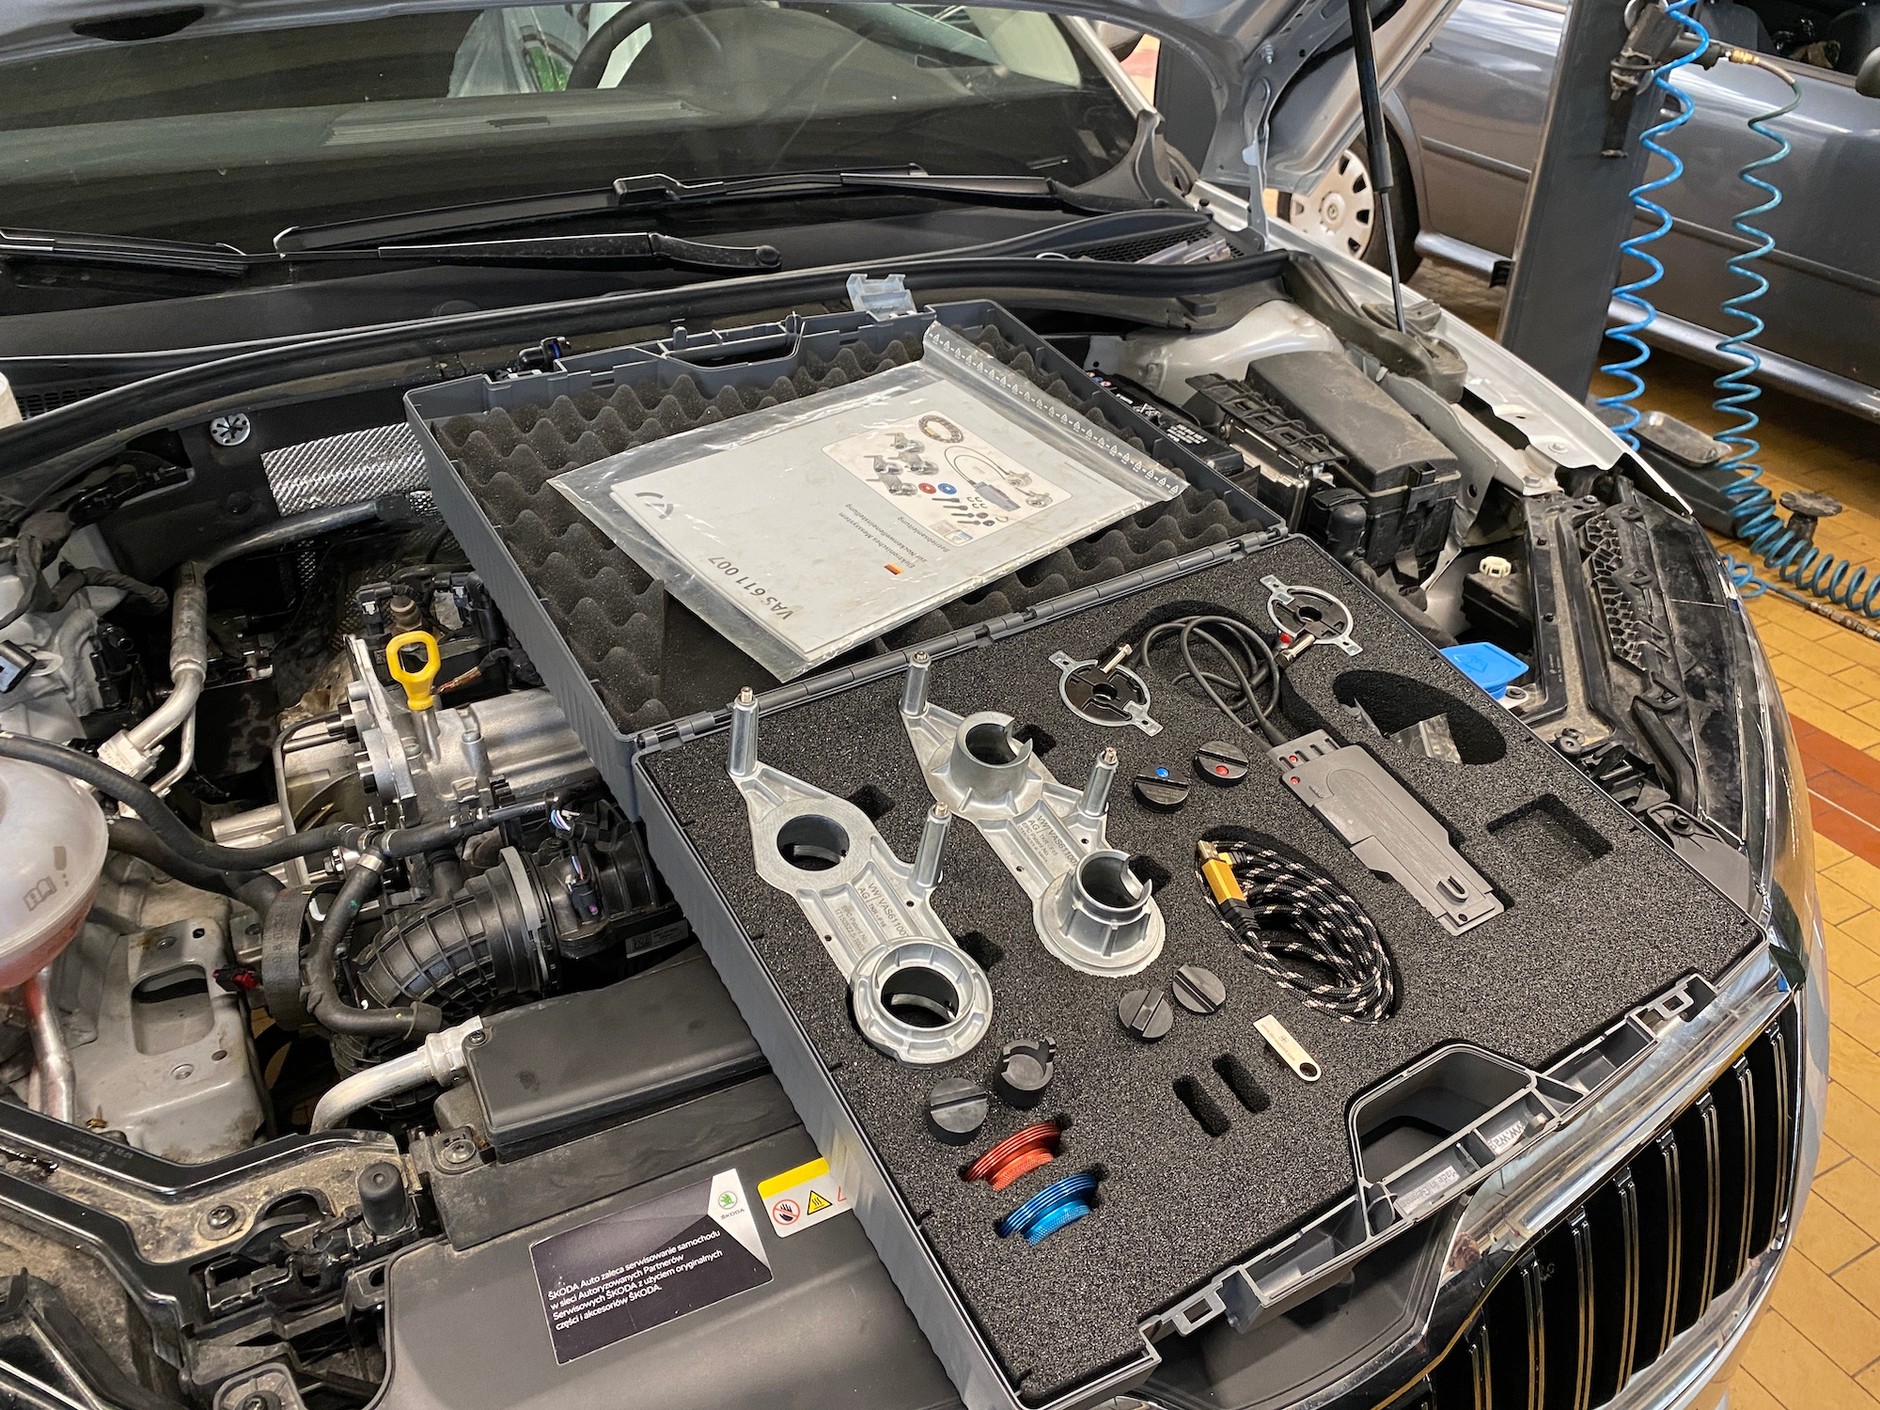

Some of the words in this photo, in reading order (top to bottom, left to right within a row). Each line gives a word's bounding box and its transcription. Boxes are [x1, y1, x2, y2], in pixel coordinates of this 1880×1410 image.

[872, 537, 916, 569] Elektronisches
[707, 557, 740, 576] 007
[735, 576, 766, 597] 611
[760, 596, 794, 620] VAS
[1027, 820, 1040, 831] AG
[1037, 815, 1051, 829] VW
[858, 887, 871, 900] AG
[868, 882, 881, 896] VW
[720, 1207, 745, 1220] ŠKODA
[547, 1282, 580, 1301] ŠKODA
[580, 1275, 601, 1289] Auto
[600, 1266, 625, 1281] zaleca
[624, 1245, 677, 1272] serwisowanie
[677, 1229, 721, 1252] samochodu
[550, 1302, 559, 1311] w
[560, 1293, 578, 1308] sieci
[578, 1268, 644, 1301] Autoryzowanych
[643, 1253, 684, 1275] Partnerów
[552, 1294, 606, 1321] Serwisowych
[605, 1281, 638, 1300] ŠKODA
[637, 1279, 644, 1287] z
[643, 1268, 676, 1286] użyciem
[675, 1249, 723, 1273] oryginalnych
[555, 1314, 580, 1331] części
[583, 1296, 629, 1320] akcesoriów
[628, 1283, 663, 1302] ŠKODA.
